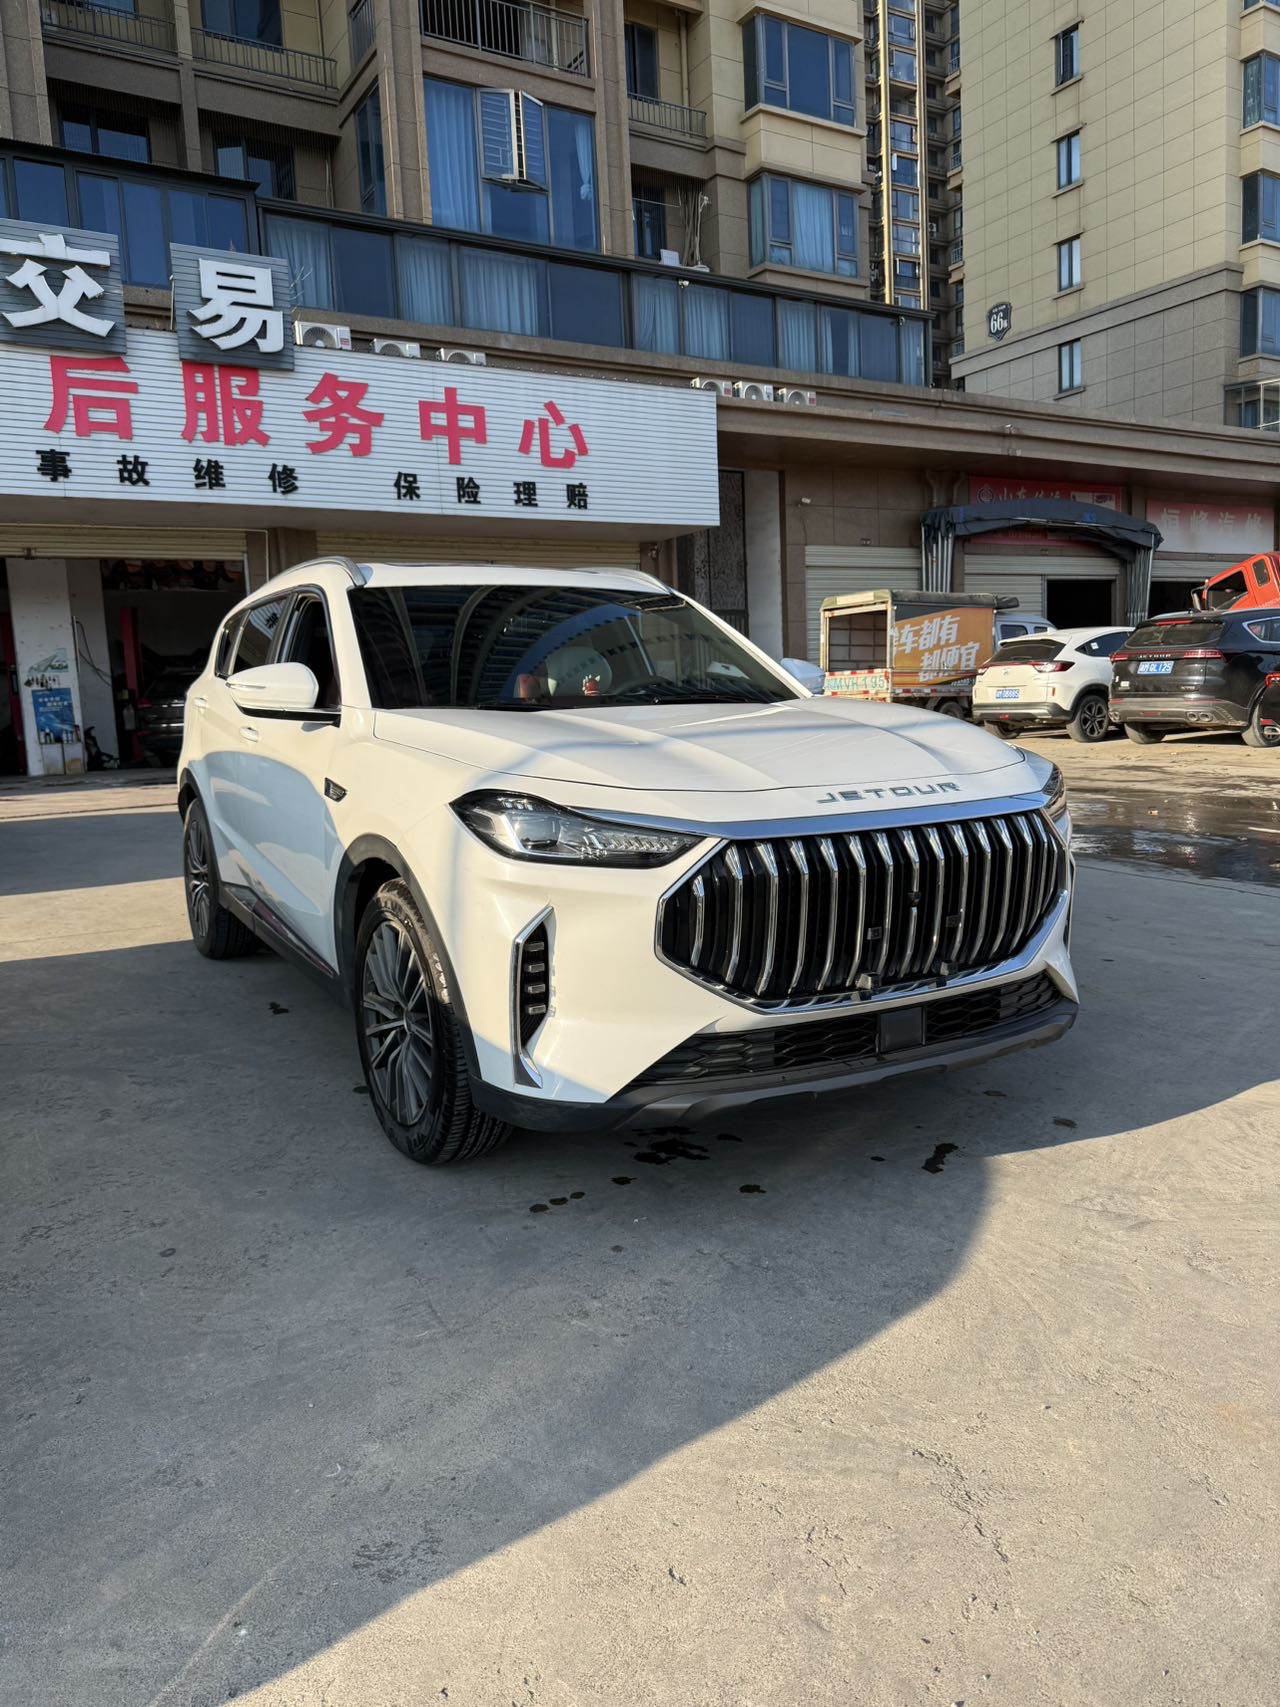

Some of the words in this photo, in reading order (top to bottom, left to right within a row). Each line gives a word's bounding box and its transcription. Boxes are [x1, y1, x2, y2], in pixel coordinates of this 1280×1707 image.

[0, 233, 284, 354] 交易
[990, 311, 1008, 333] 66
[44, 356, 588, 469] 后服务中心
[36, 449, 299, 496] 事故维修
[393, 470, 589, 511] 保险理赔
[817, 782, 963, 804] JETOUR
